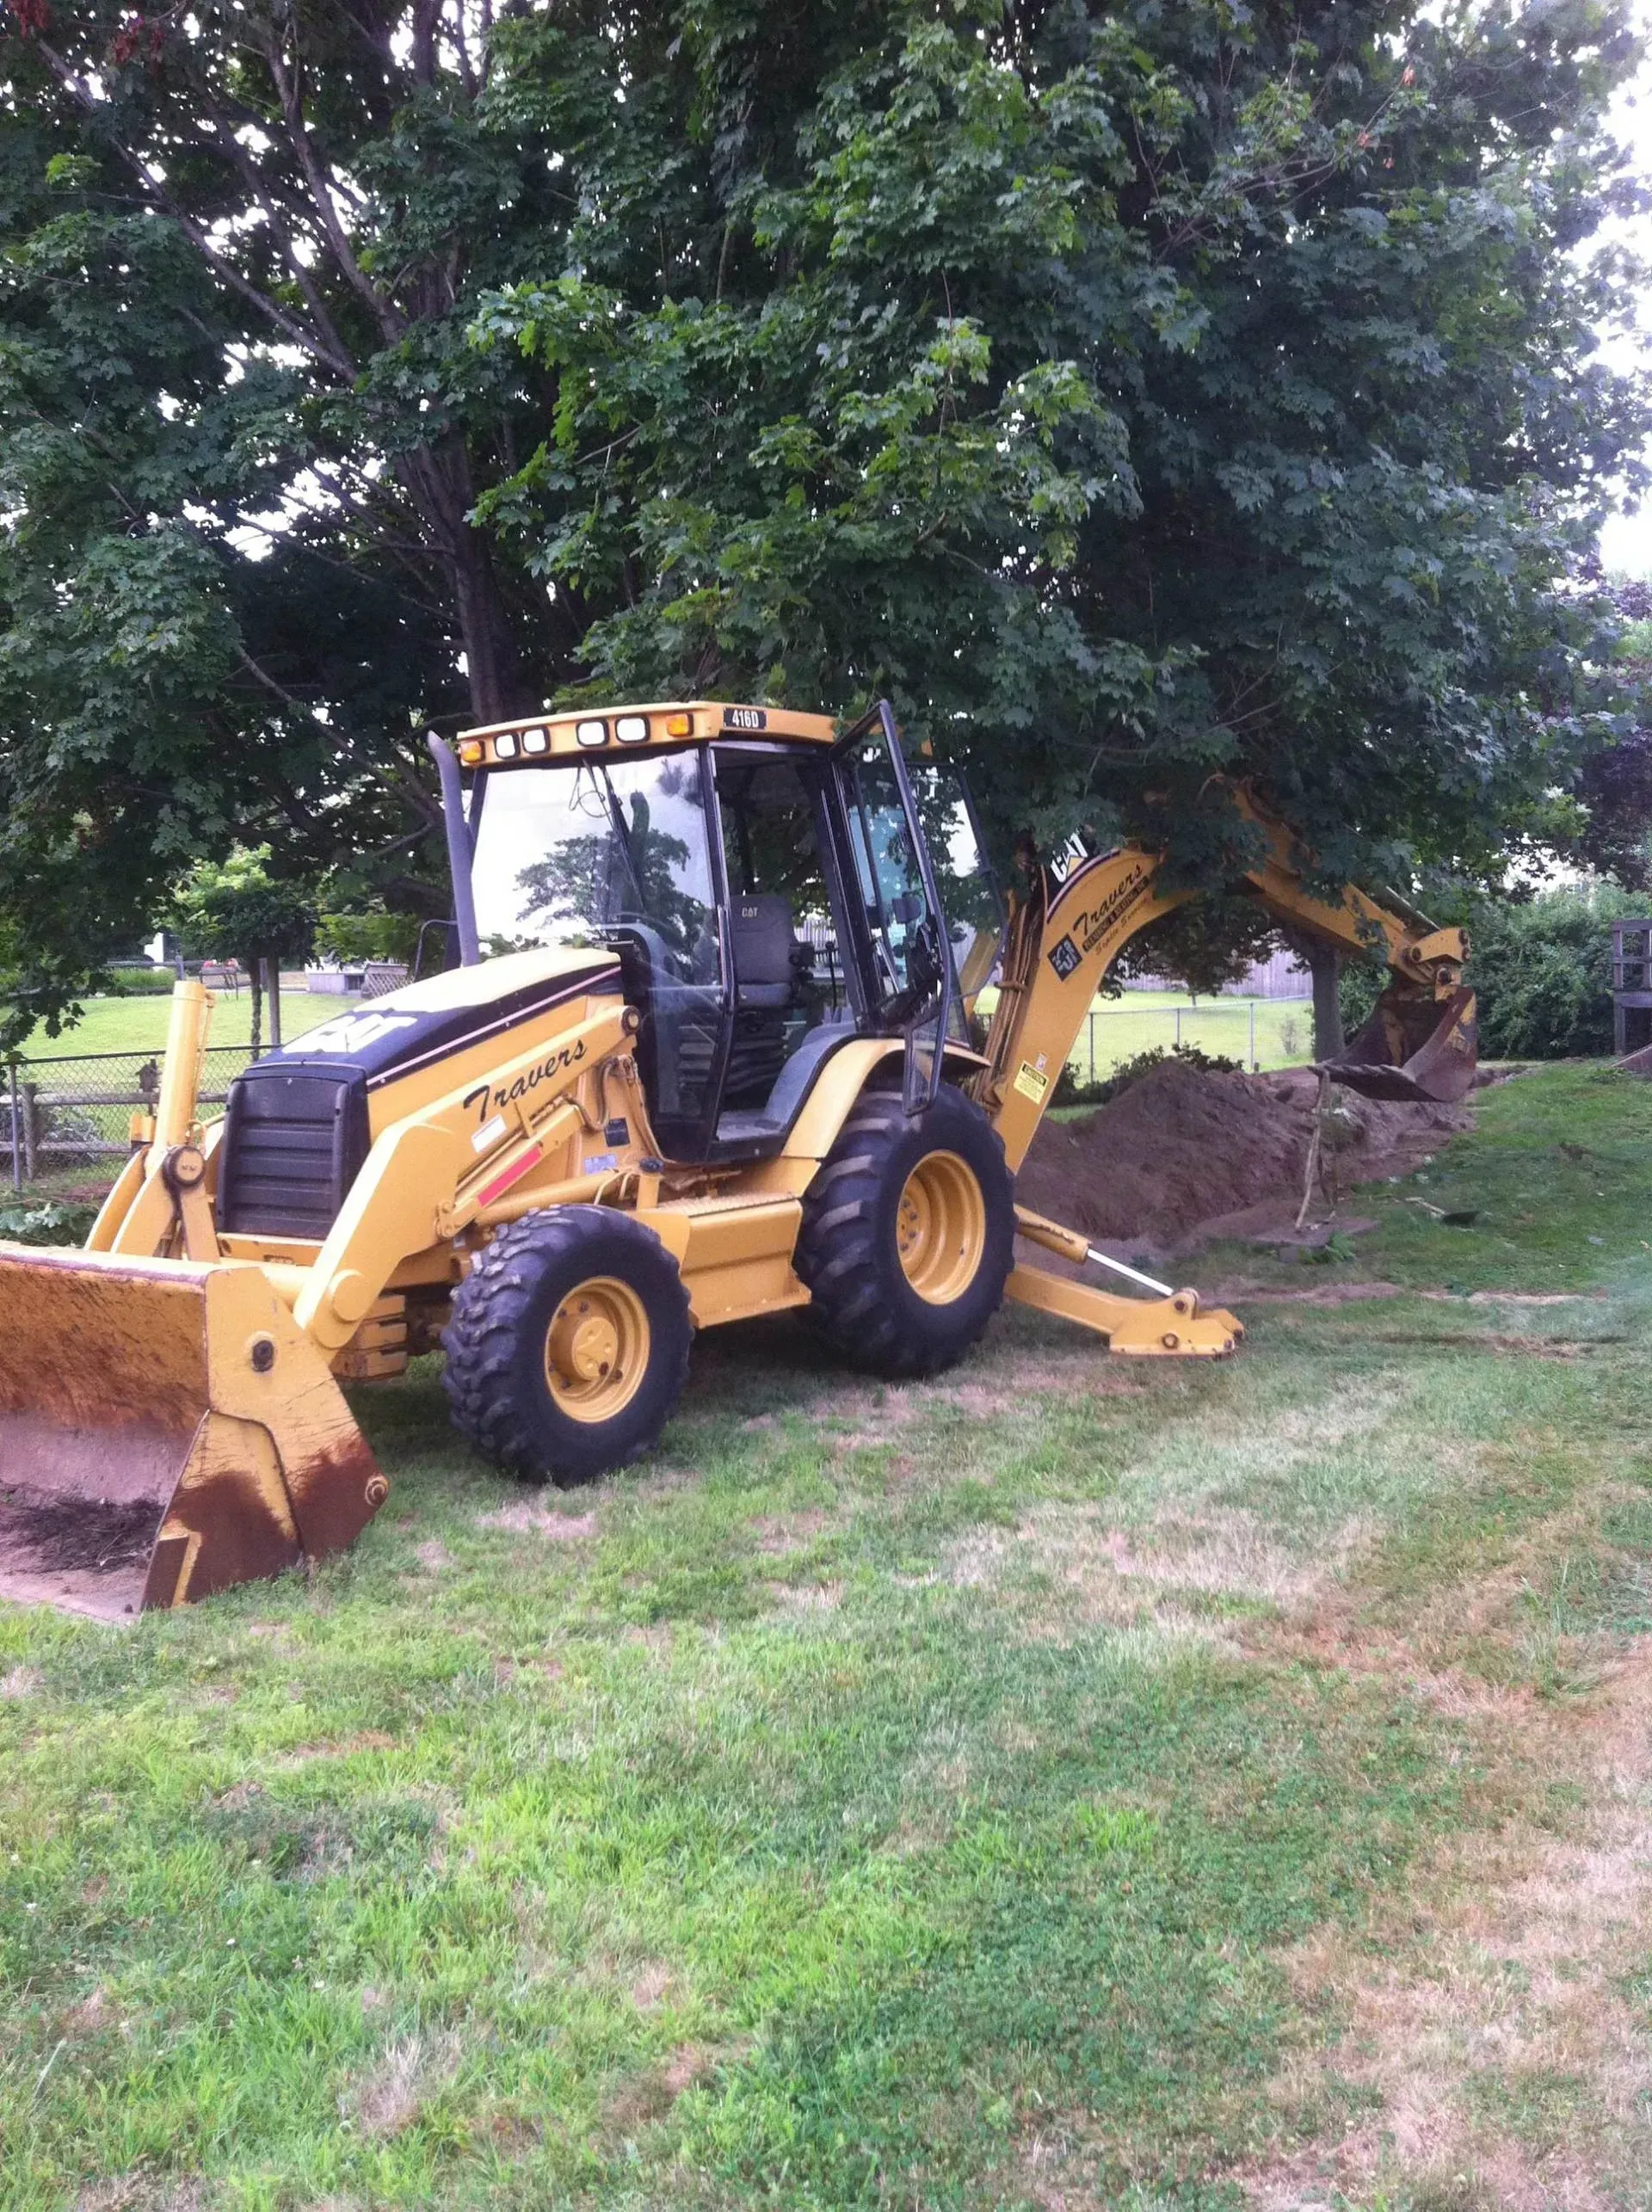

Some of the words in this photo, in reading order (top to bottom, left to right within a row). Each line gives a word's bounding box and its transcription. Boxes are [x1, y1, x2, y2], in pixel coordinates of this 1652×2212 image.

[731, 708, 760, 729] 416D
[742, 907, 759, 919] CAT
[1072, 862, 1143, 937] Travers
[463, 1038, 589, 1122] Travers
